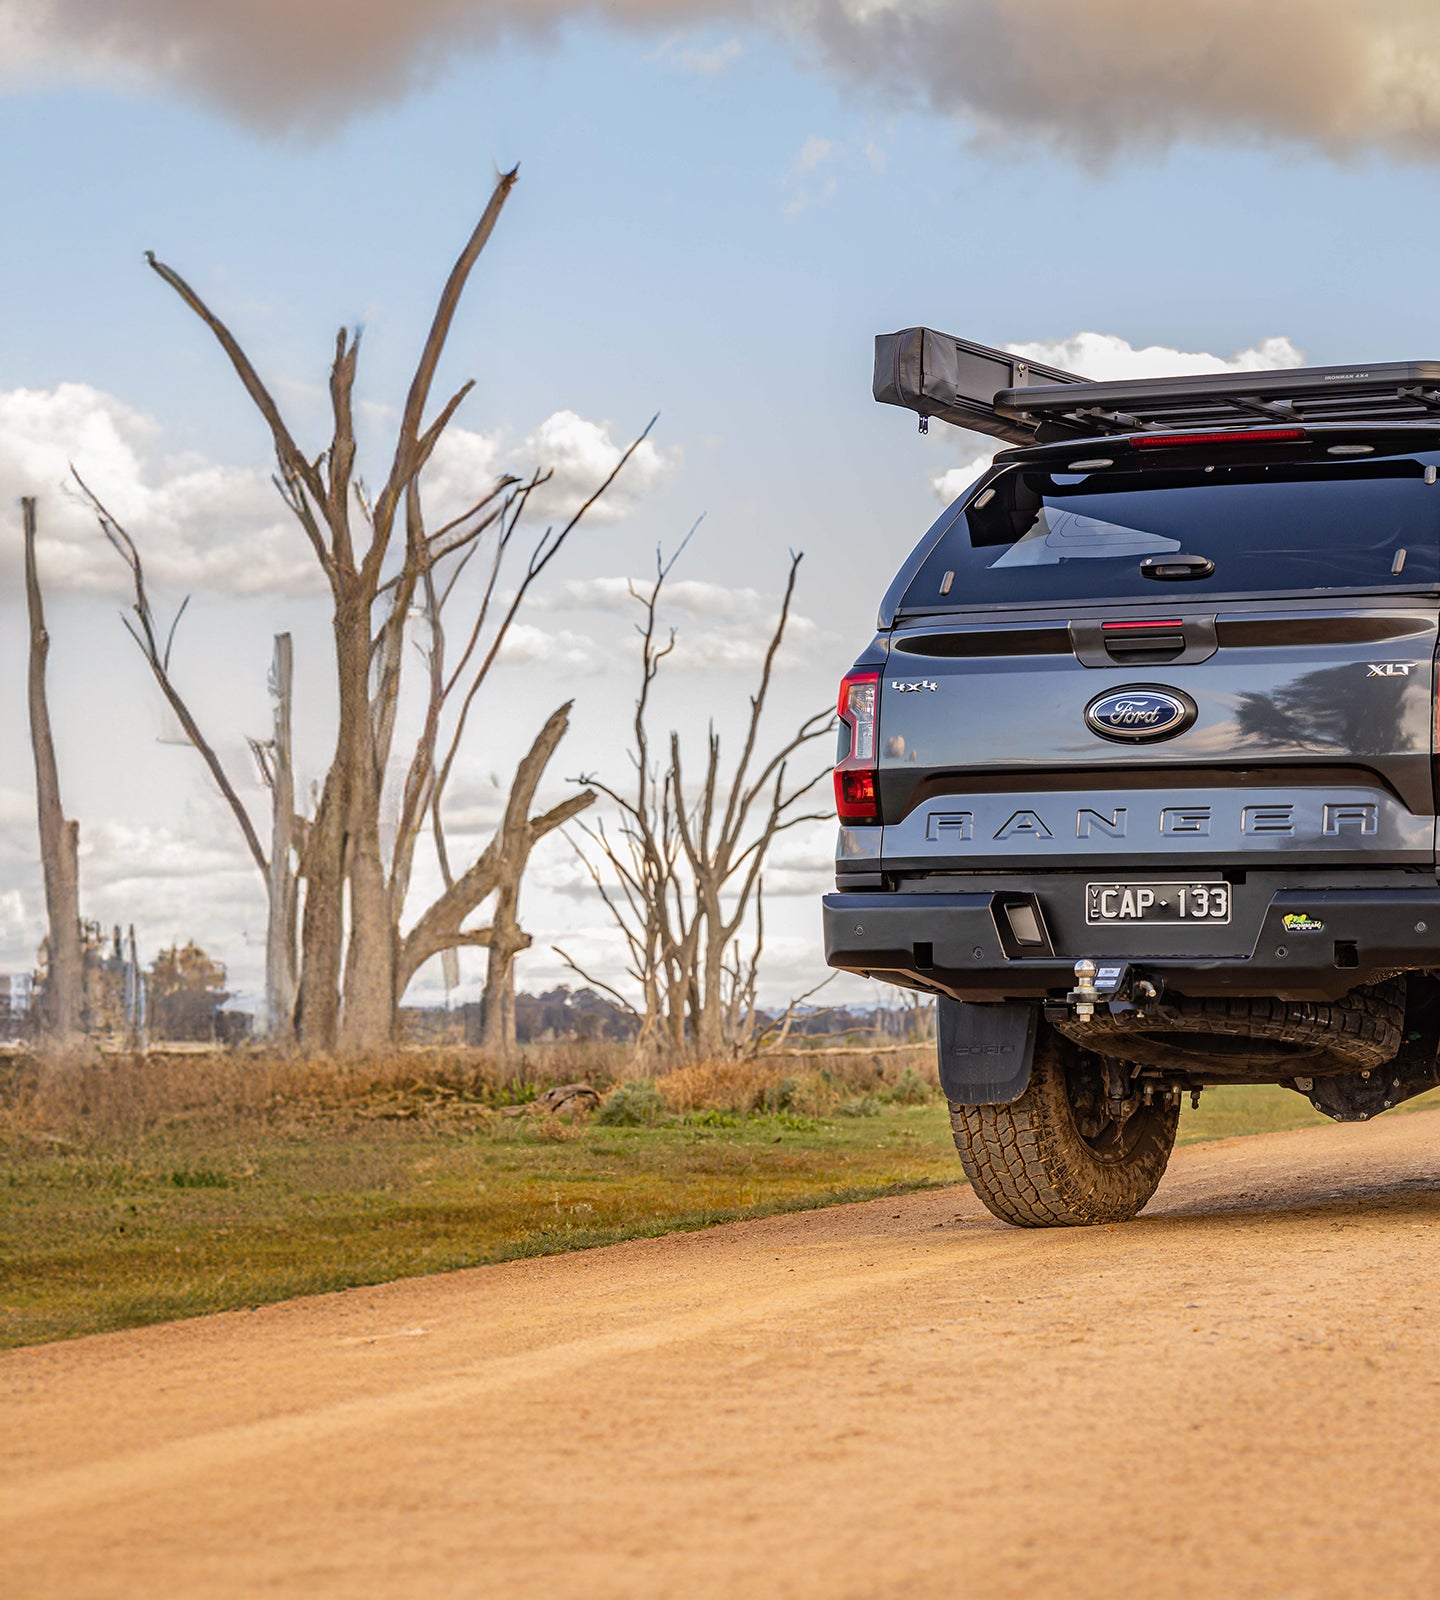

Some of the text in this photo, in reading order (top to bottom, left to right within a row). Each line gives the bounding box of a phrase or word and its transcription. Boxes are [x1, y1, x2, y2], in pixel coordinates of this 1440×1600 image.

[1366, 663, 1418, 677] XLT
[1110, 700, 1161, 725] Ford
[924, 803, 1380, 841] RANGER
[1090, 889, 1100, 918] VIC
[1101, 888, 1228, 918] CAP 133
